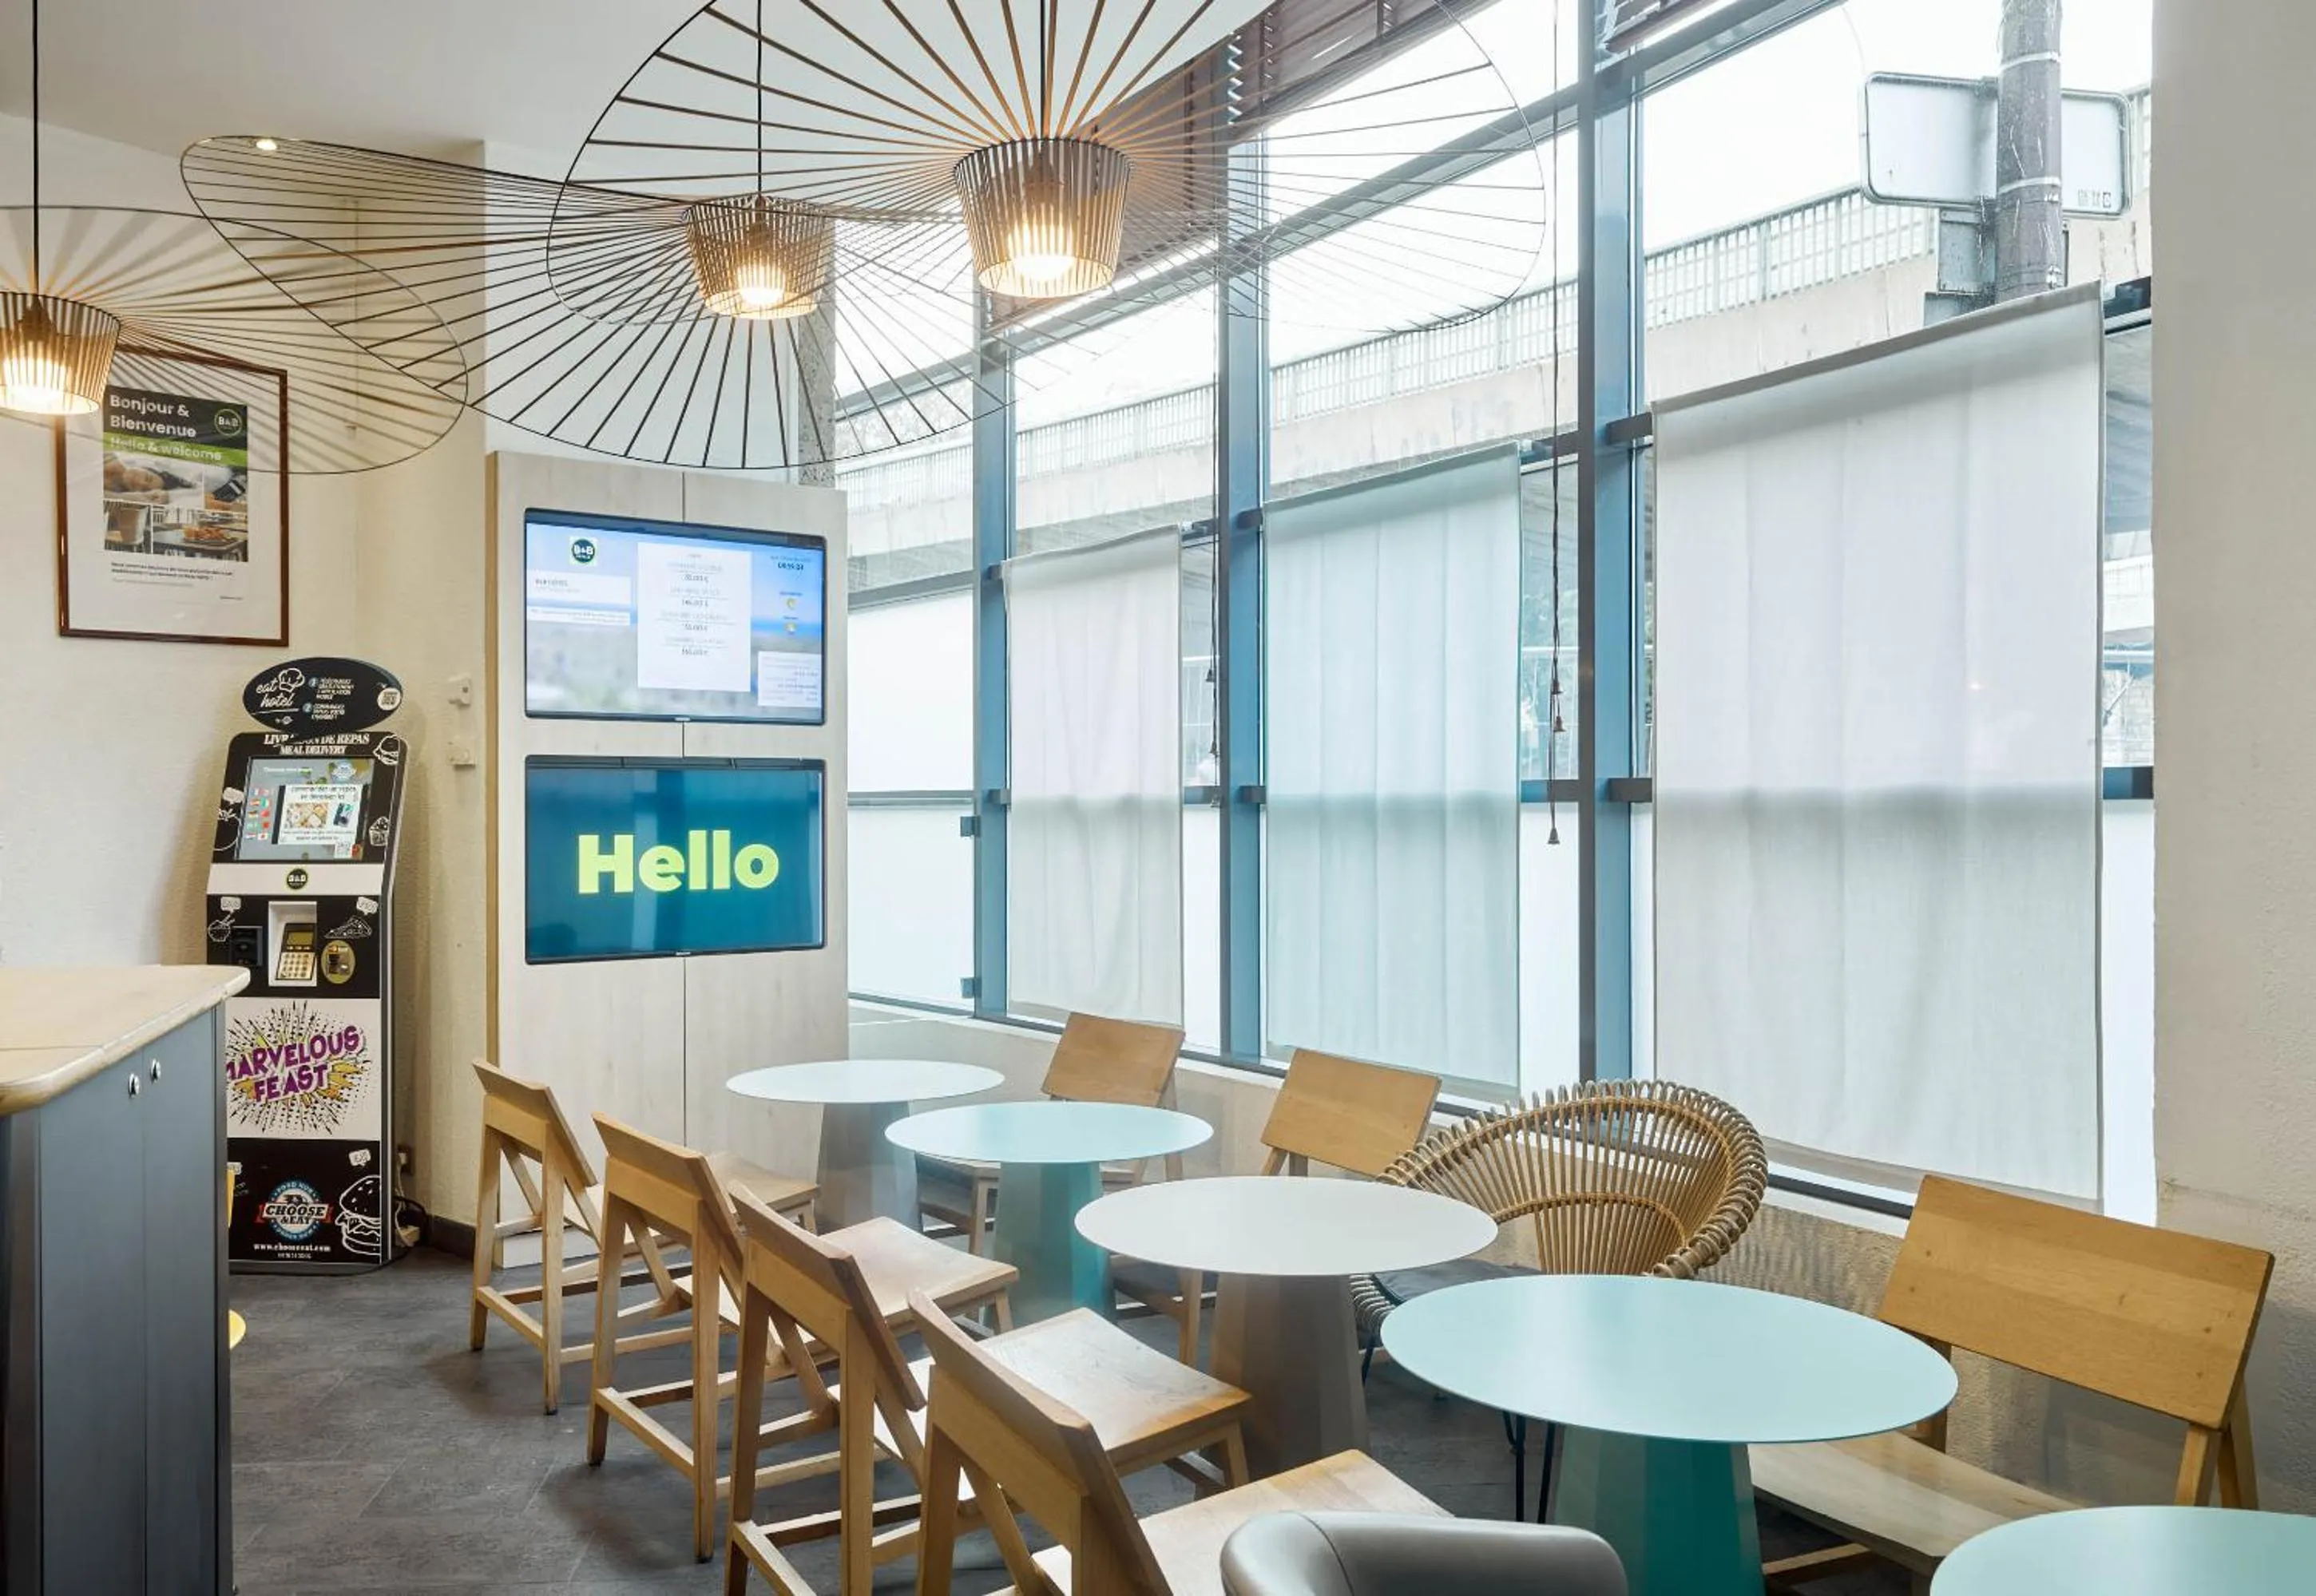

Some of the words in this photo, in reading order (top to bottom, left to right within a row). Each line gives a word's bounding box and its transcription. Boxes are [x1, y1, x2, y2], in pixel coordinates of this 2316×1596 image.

[110, 394, 174, 414] Bonjour
[176, 404, 189, 418] &
[110, 415, 196, 438] Bienvenue
[110, 437, 146, 451] Hello
[148, 442, 159, 453] &
[159, 444, 223, 461] welcome
[256, 677, 278, 694] eat
[260, 691, 295, 708] hotel
[336, 734, 370, 745] REPAS
[280, 744, 304, 755] MEAL
[304, 745, 348, 755] DELIVERY
[578, 830, 780, 894] Hello
[253, 1064, 327, 1102] FEAST
[266, 1205, 325, 1215] CHOOSE
[280, 1216, 311, 1225] &EAT
